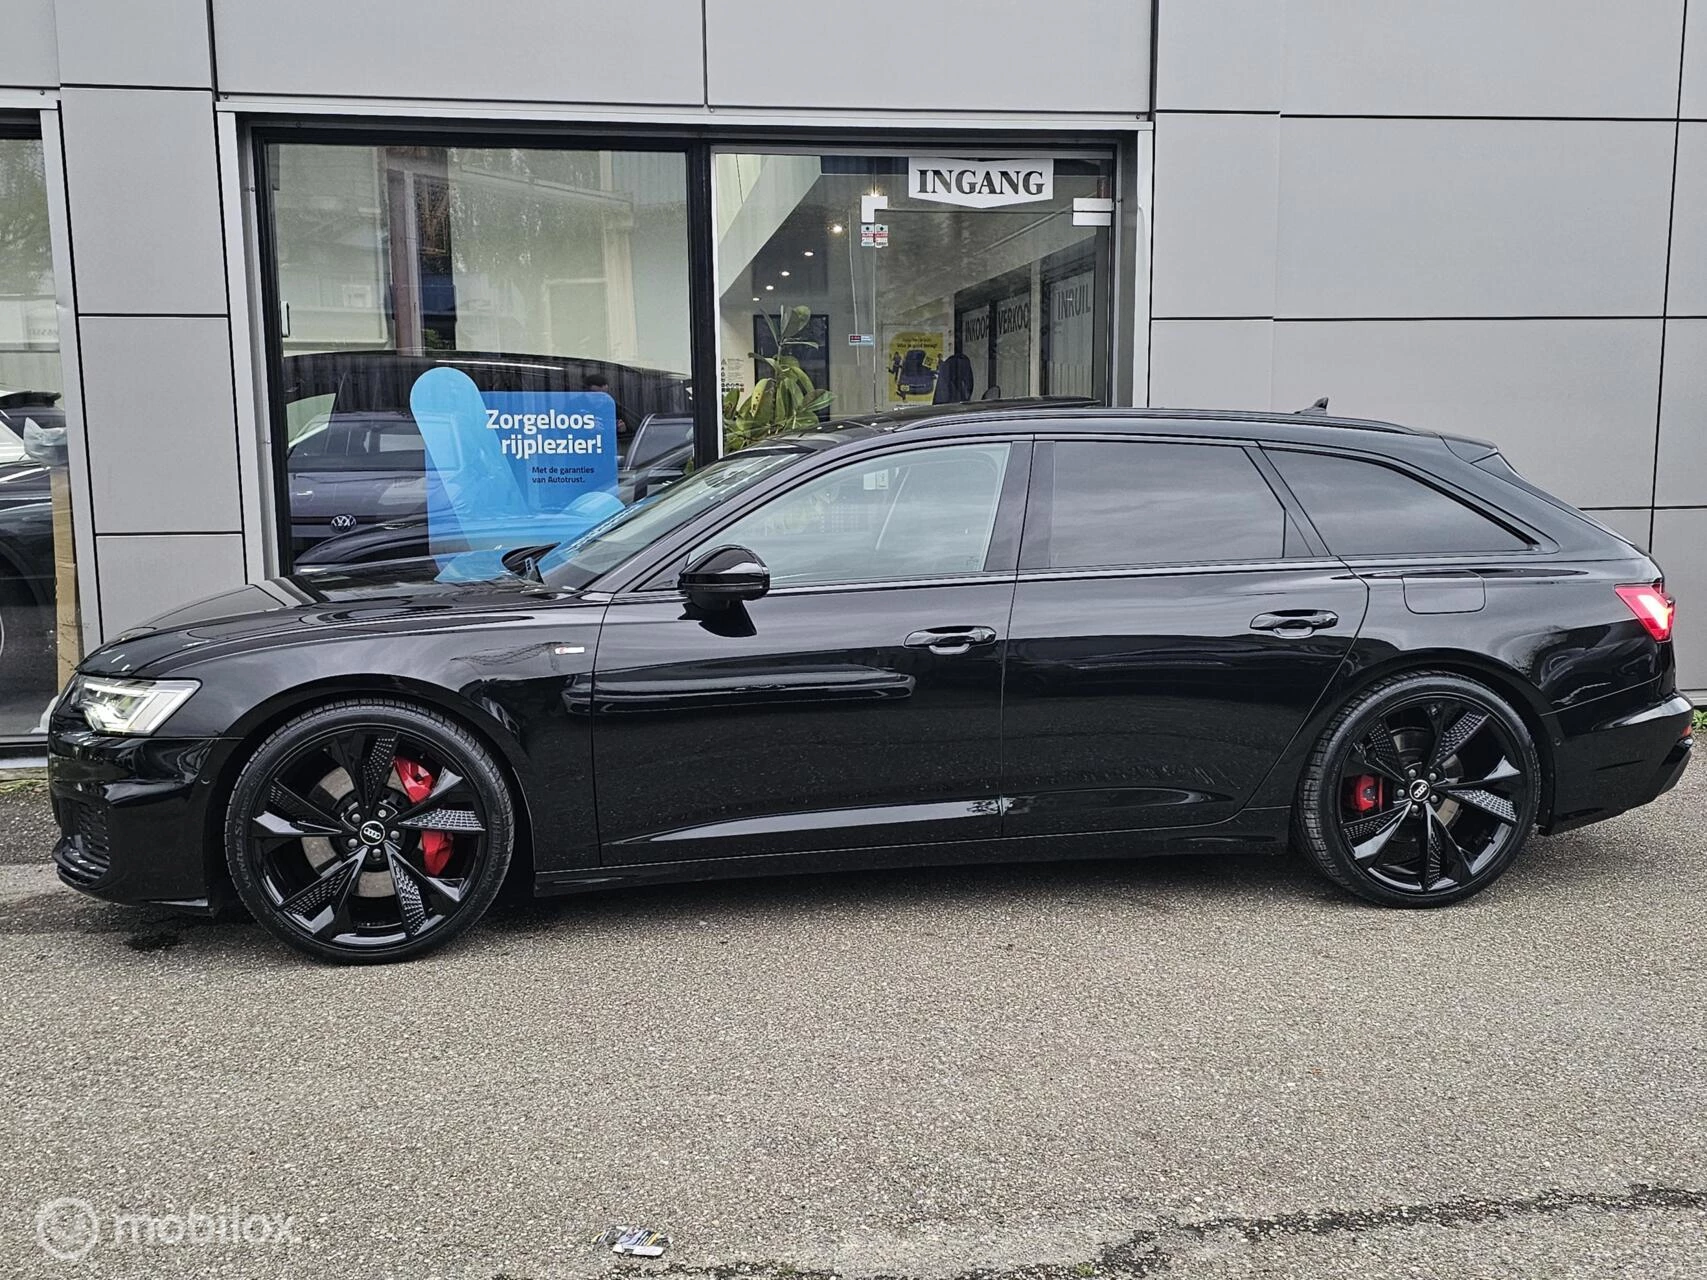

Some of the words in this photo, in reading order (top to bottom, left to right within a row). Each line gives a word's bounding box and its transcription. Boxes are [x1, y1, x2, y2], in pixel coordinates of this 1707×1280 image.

[917, 169, 1045, 196] INGANG
[1057, 283, 1091, 320] INRUIL
[998, 302, 1030, 335] VERKOO
[485, 409, 595, 435] Zorgeloos
[501, 434, 603, 459] rijplezier!
[531, 466, 547, 474] Met
[549, 466, 558, 474] de
[559, 466, 595, 476] garanties
[531, 476, 546, 484] van
[548, 475, 586, 484] Autotrust.
